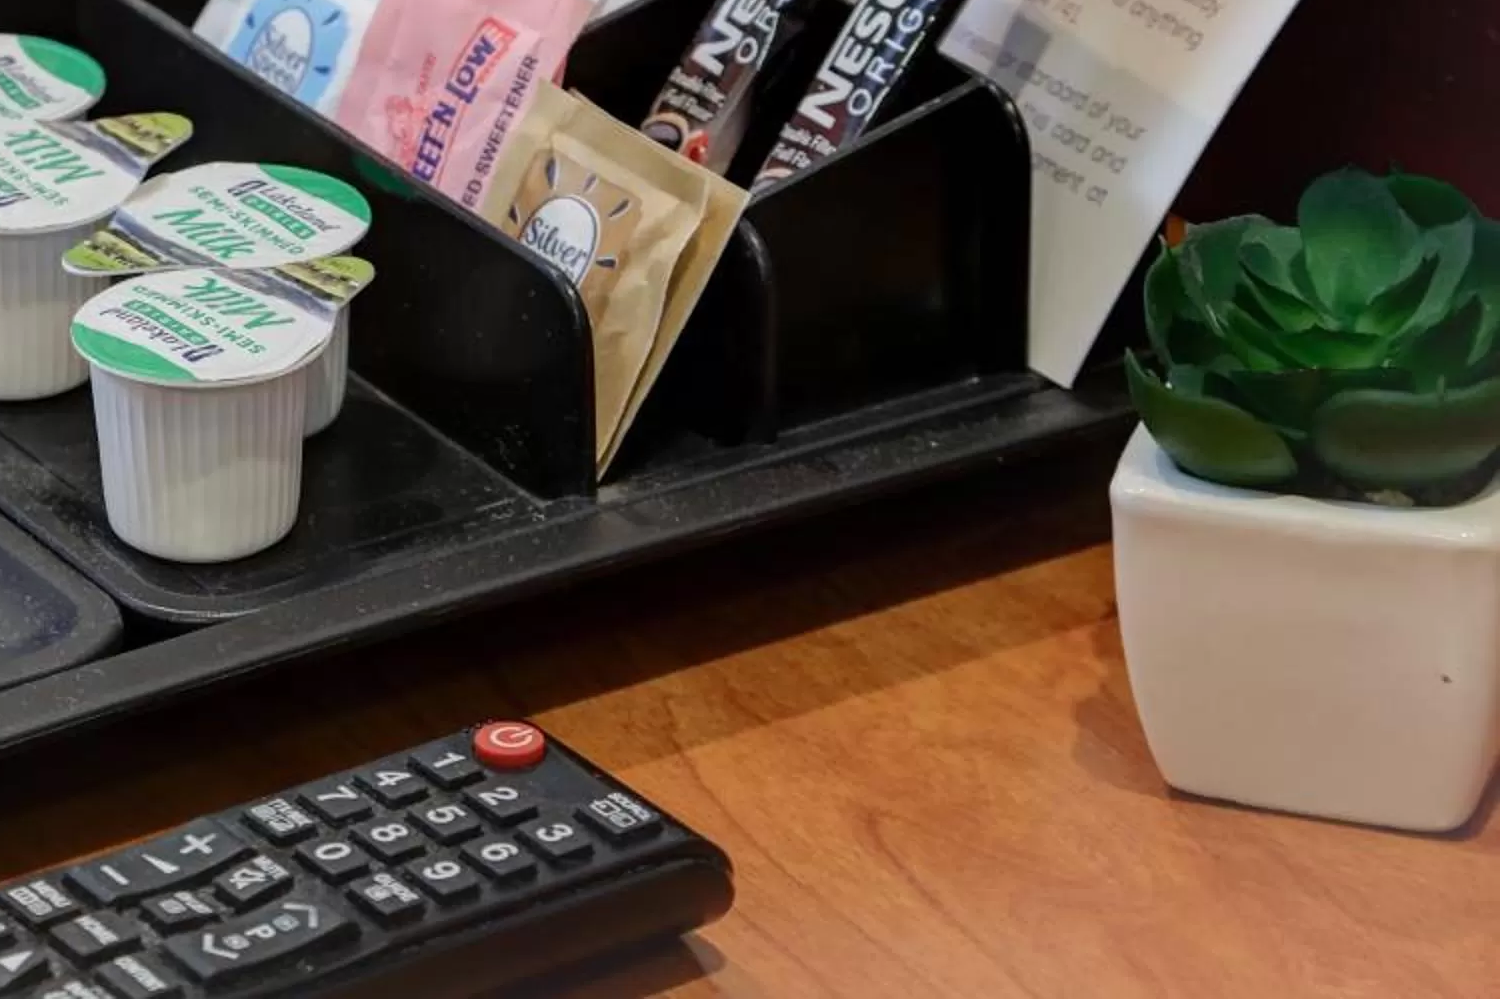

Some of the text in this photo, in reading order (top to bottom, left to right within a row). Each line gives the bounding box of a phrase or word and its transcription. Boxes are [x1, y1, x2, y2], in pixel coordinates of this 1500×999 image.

[476, 51, 539, 174] SWEETENER
[412, 99, 457, 183] EET'N
[259, 186, 341, 232] Lakeland
[188, 187, 305, 254] SEMI-SKIMMED
[525, 217, 588, 266] Silver
[132, 284, 266, 353] SEMI-SKIMMED
[100, 307, 185, 352] Lakeland
[433, 752, 467, 768] 1
[375, 770, 411, 787] 4
[316, 785, 357, 805] 7
[478, 787, 519, 806] 2
[426, 806, 467, 825] 5
[371, 823, 409, 842] 8
[536, 824, 573, 842] 3
[314, 842, 351, 860] 0
[480, 843, 519, 862] 6
[423, 861, 461, 880] 9
[244, 923, 276, 939] P
